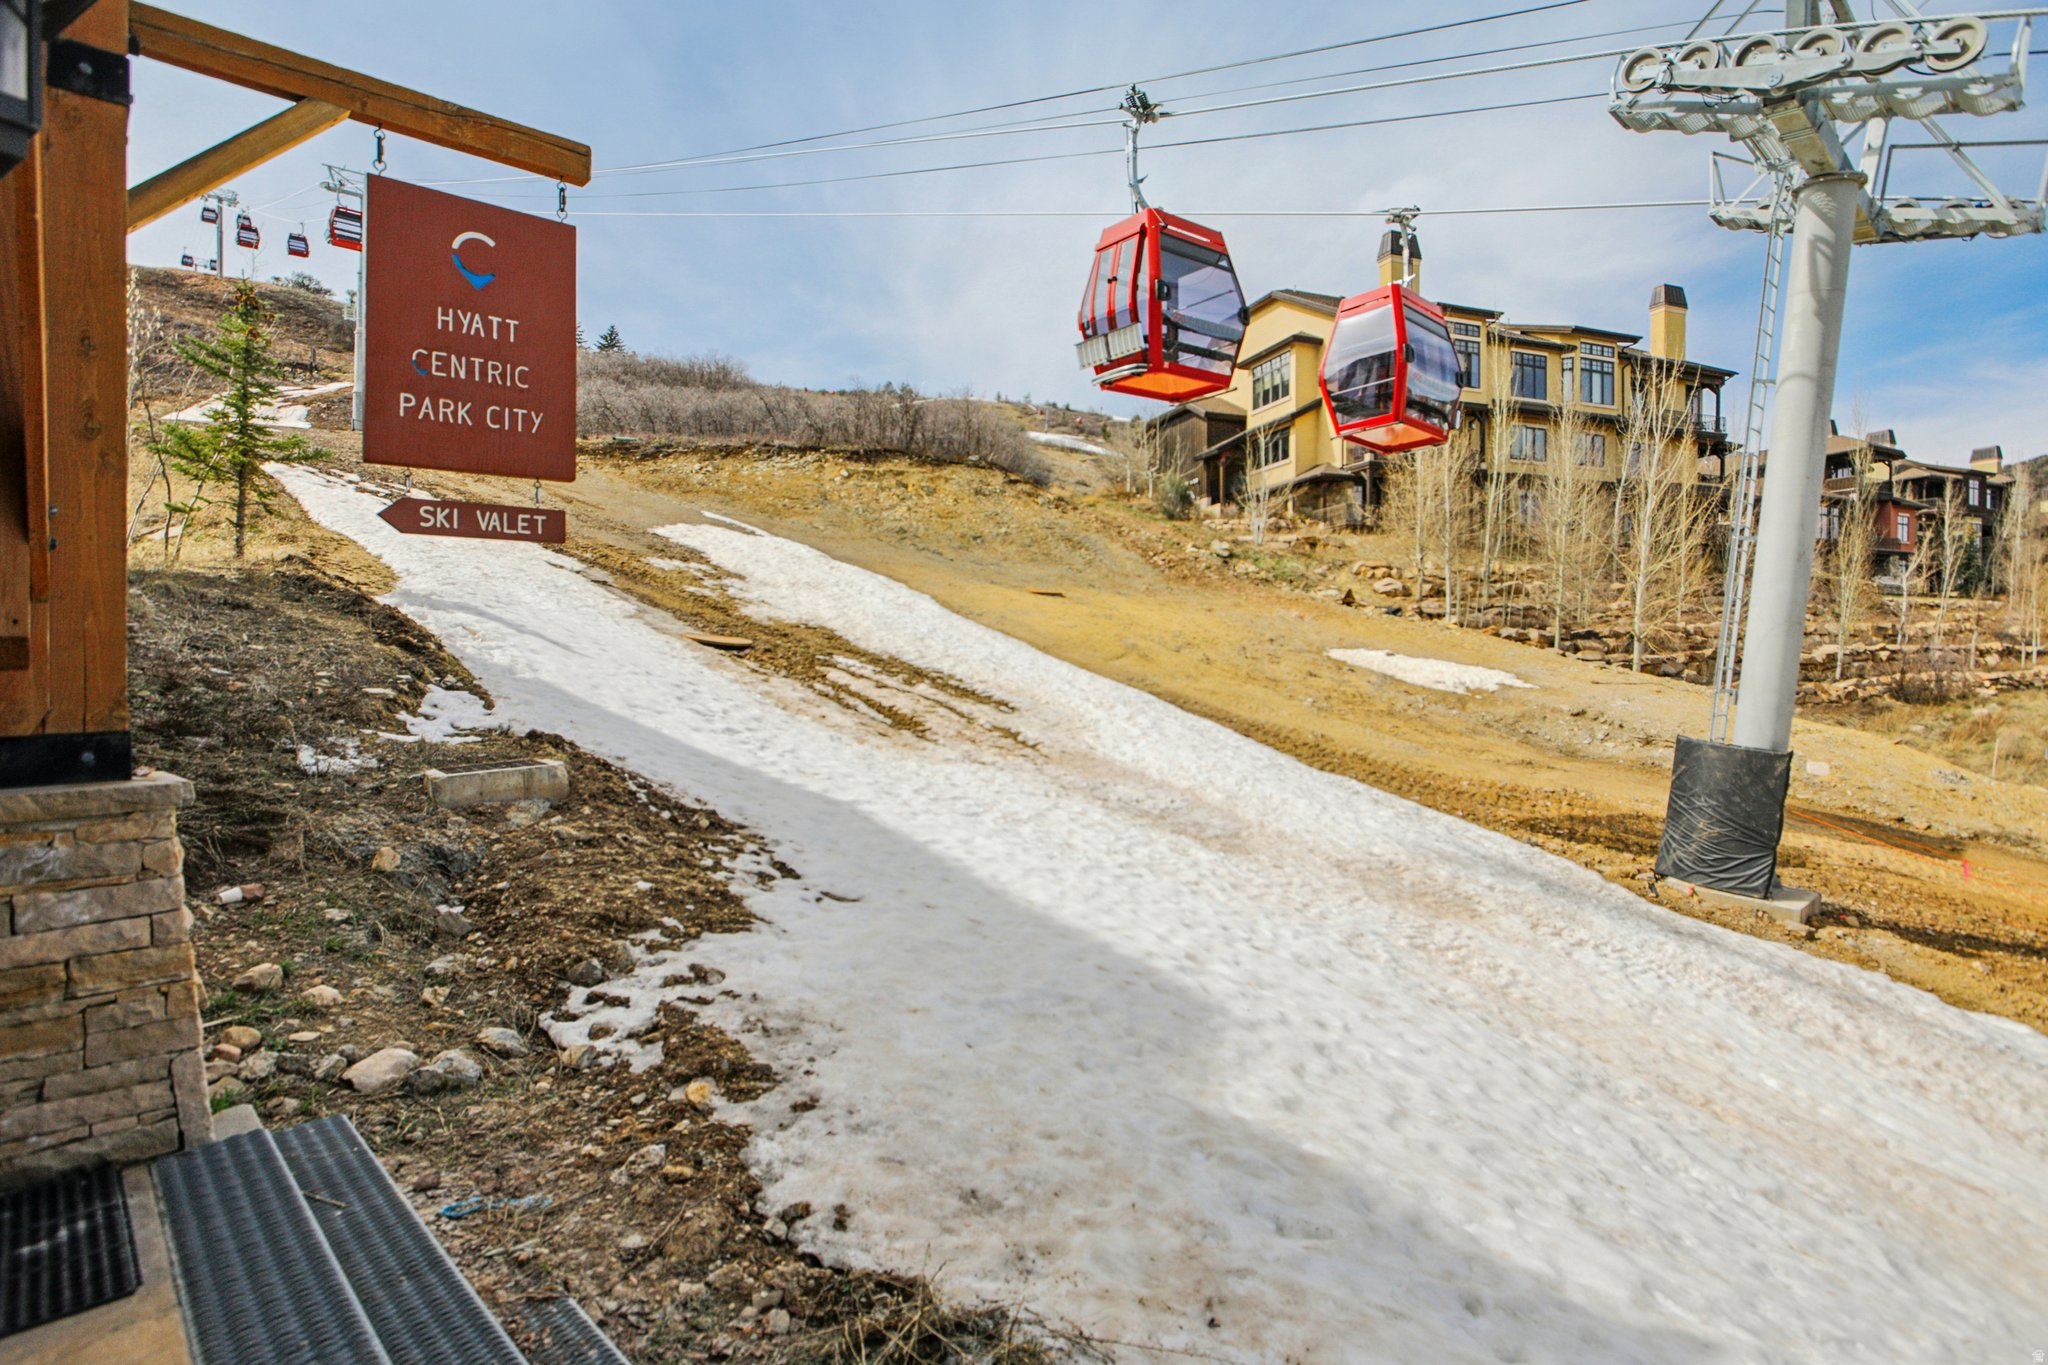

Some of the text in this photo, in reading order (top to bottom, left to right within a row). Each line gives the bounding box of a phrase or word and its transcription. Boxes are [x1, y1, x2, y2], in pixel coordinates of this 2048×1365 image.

[437, 306, 519, 343] HYATT
[412, 348, 529, 389] CENTRIC
[399, 392, 544, 434] PARK CITY
[419, 505, 547, 535] SKI VALET
